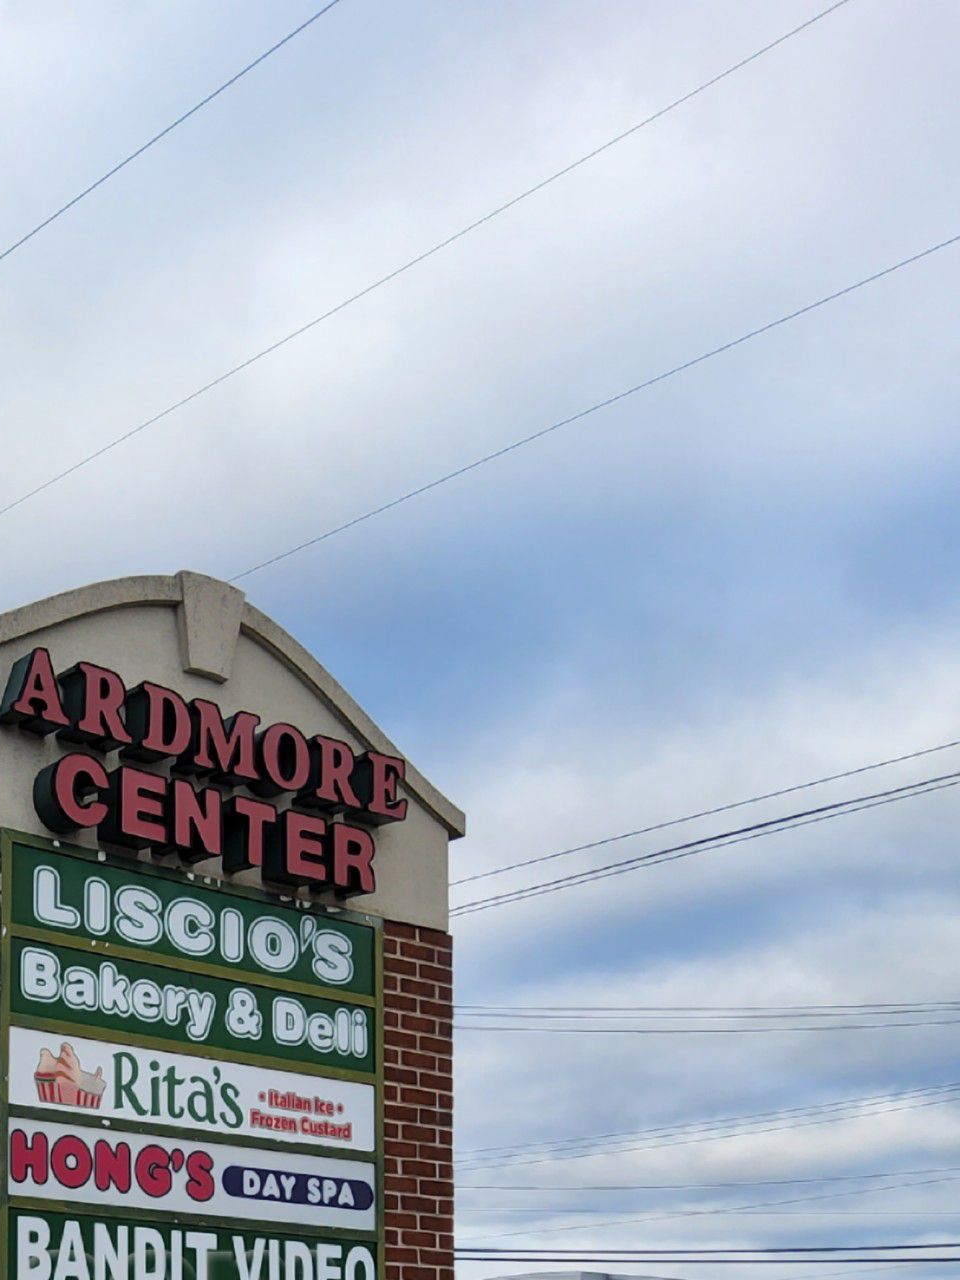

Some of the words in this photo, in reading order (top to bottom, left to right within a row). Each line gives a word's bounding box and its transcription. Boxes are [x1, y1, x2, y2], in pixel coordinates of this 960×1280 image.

[6, 647, 408, 823] ARDMORE
[48, 752, 376, 894] CENTER
[33, 865, 353, 985] LISCIO'S
[20, 946, 216, 1041] Bakery
[225, 987, 263, 1040] &
[272, 996, 369, 1059] Deli
[112, 1051, 244, 1129] Rita's
[250, 1108, 297, 1133] Frozen
[301, 1119, 353, 1142] Custard
[268, 1088, 312, 1112] Italian
[314, 1097, 335, 1116] Ice
[10, 1128, 215, 1202] HONG'S
[242, 1169, 296, 1201] DAY
[307, 1177, 356, 1208] SPA
